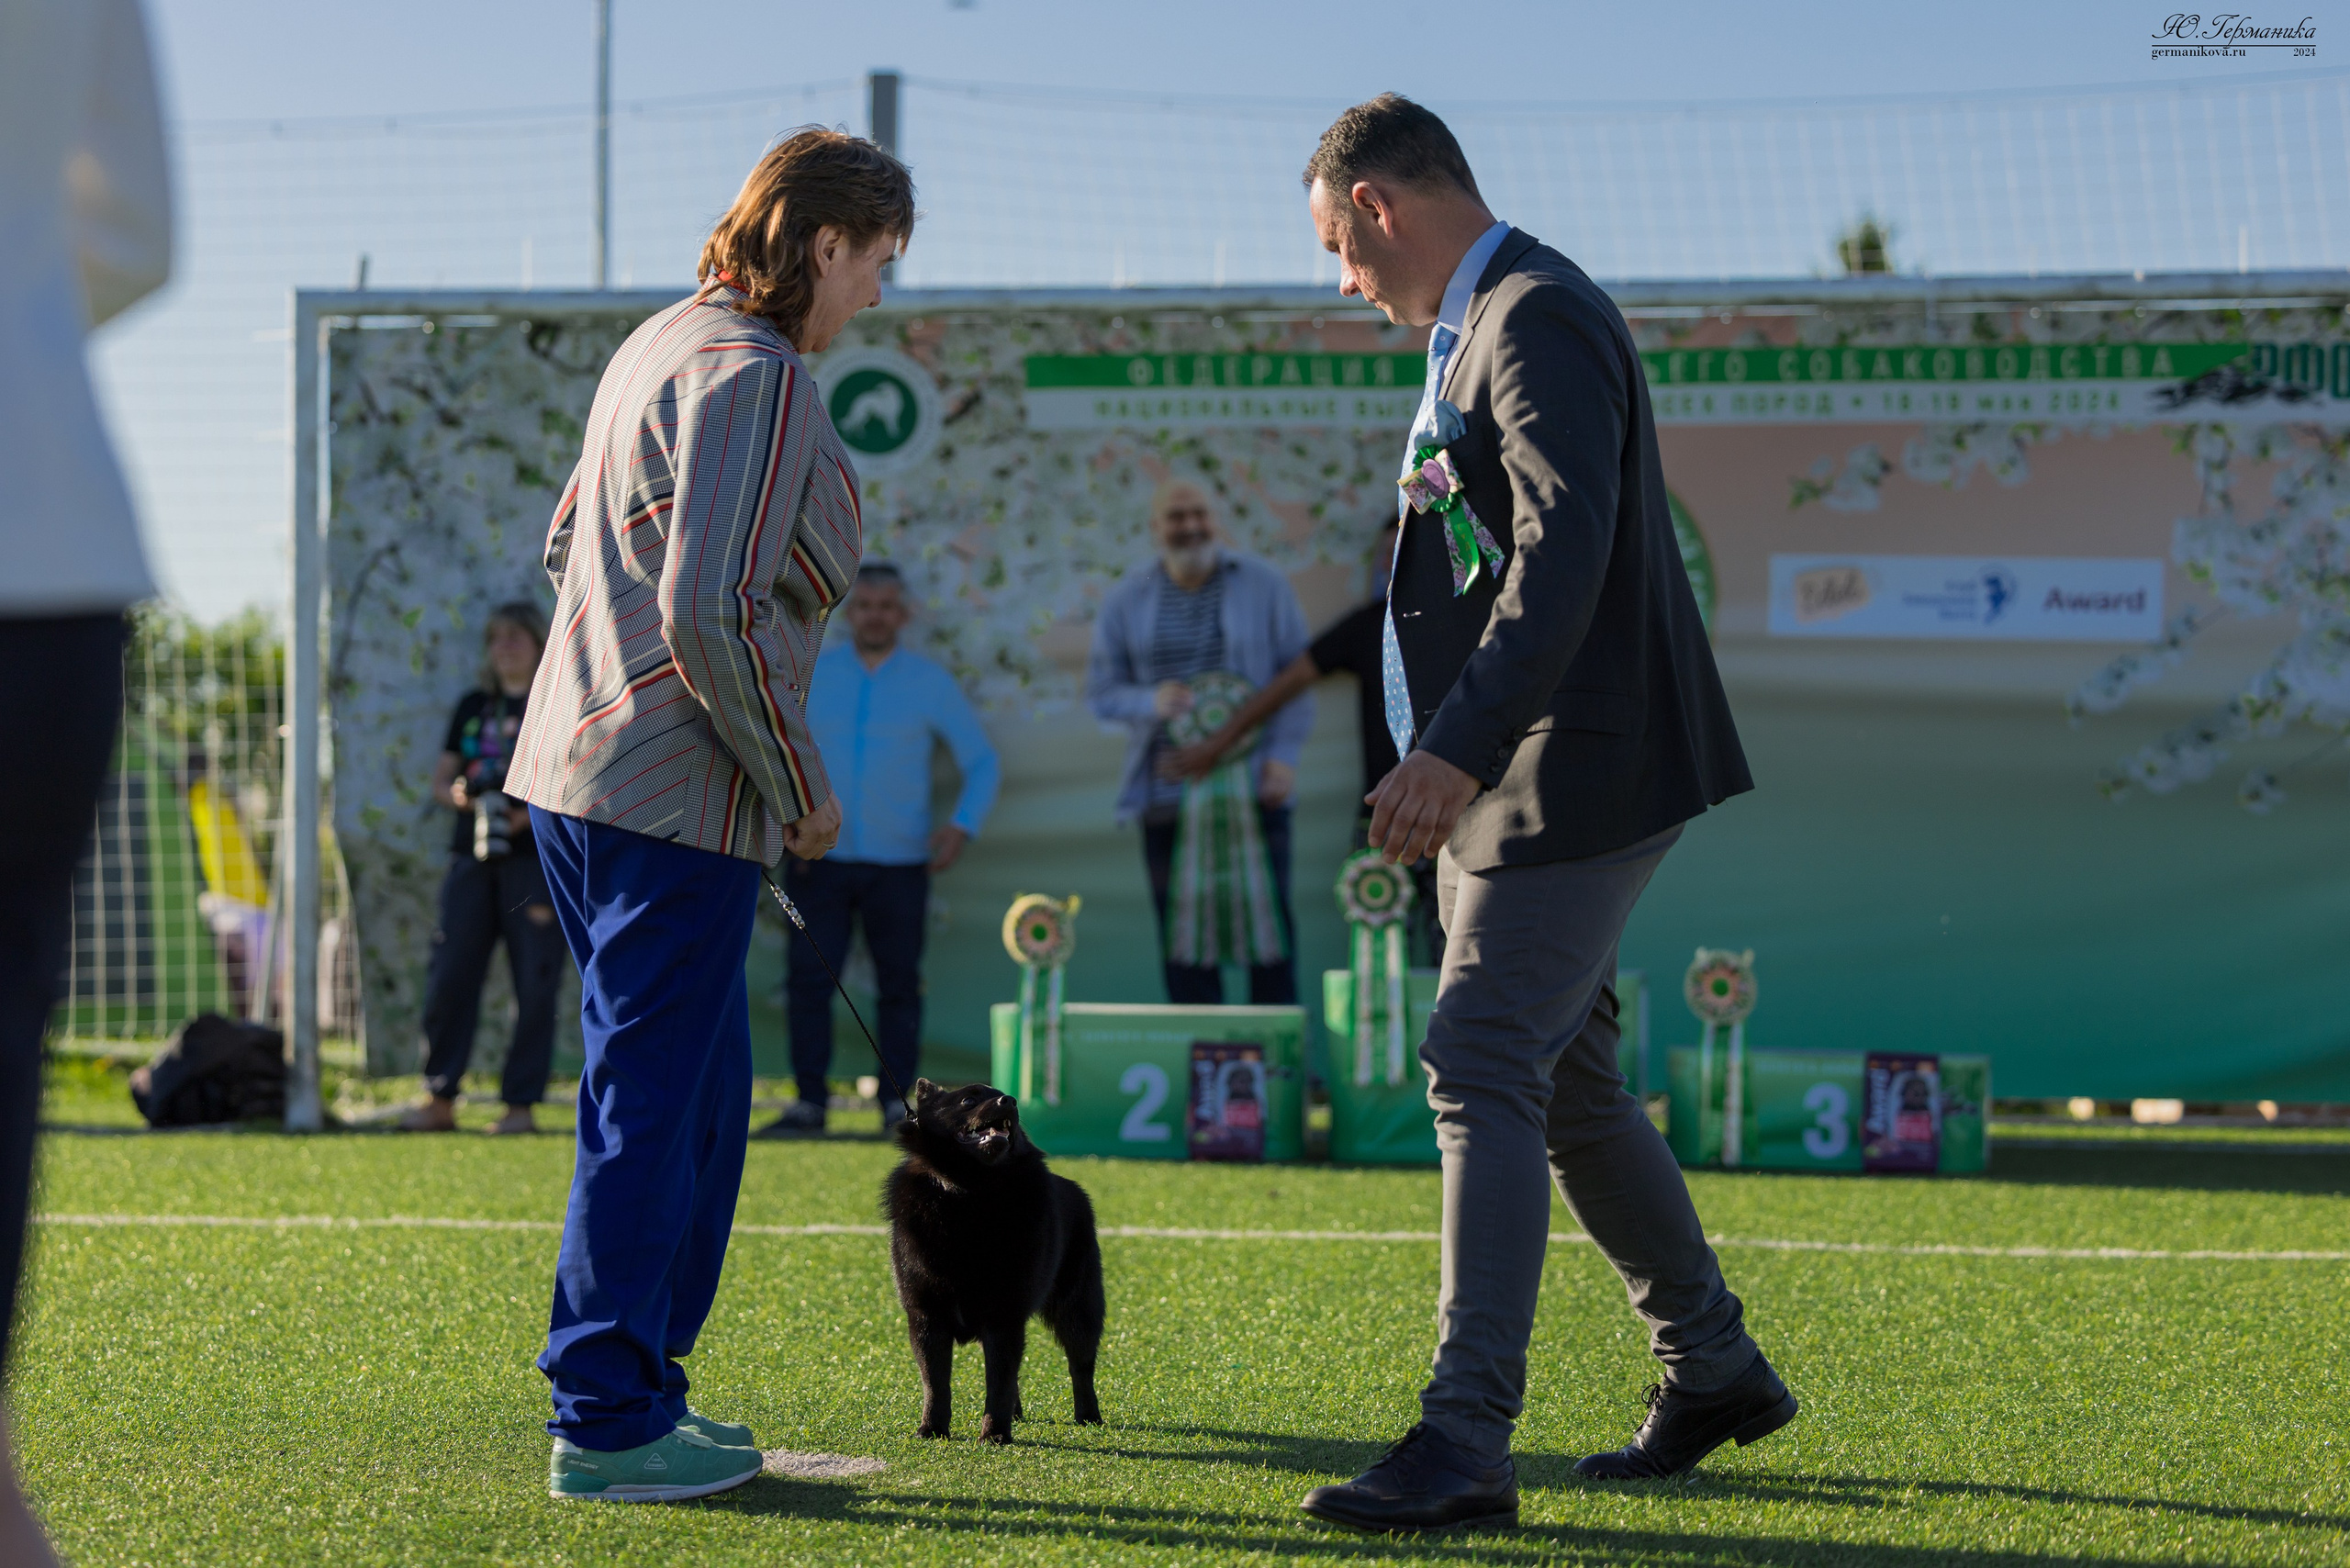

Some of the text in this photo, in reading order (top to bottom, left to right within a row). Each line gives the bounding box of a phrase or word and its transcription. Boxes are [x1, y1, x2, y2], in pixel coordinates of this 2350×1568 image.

[1126, 354, 1394, 386] ФЕДЕРАЦИЯ
[1778, 346, 2175, 383] СОБАКОВОДСТВА
[2042, 586, 2146, 614] Award
[1118, 1062, 1172, 1142] 2
[1802, 1081, 1850, 1159] 3
